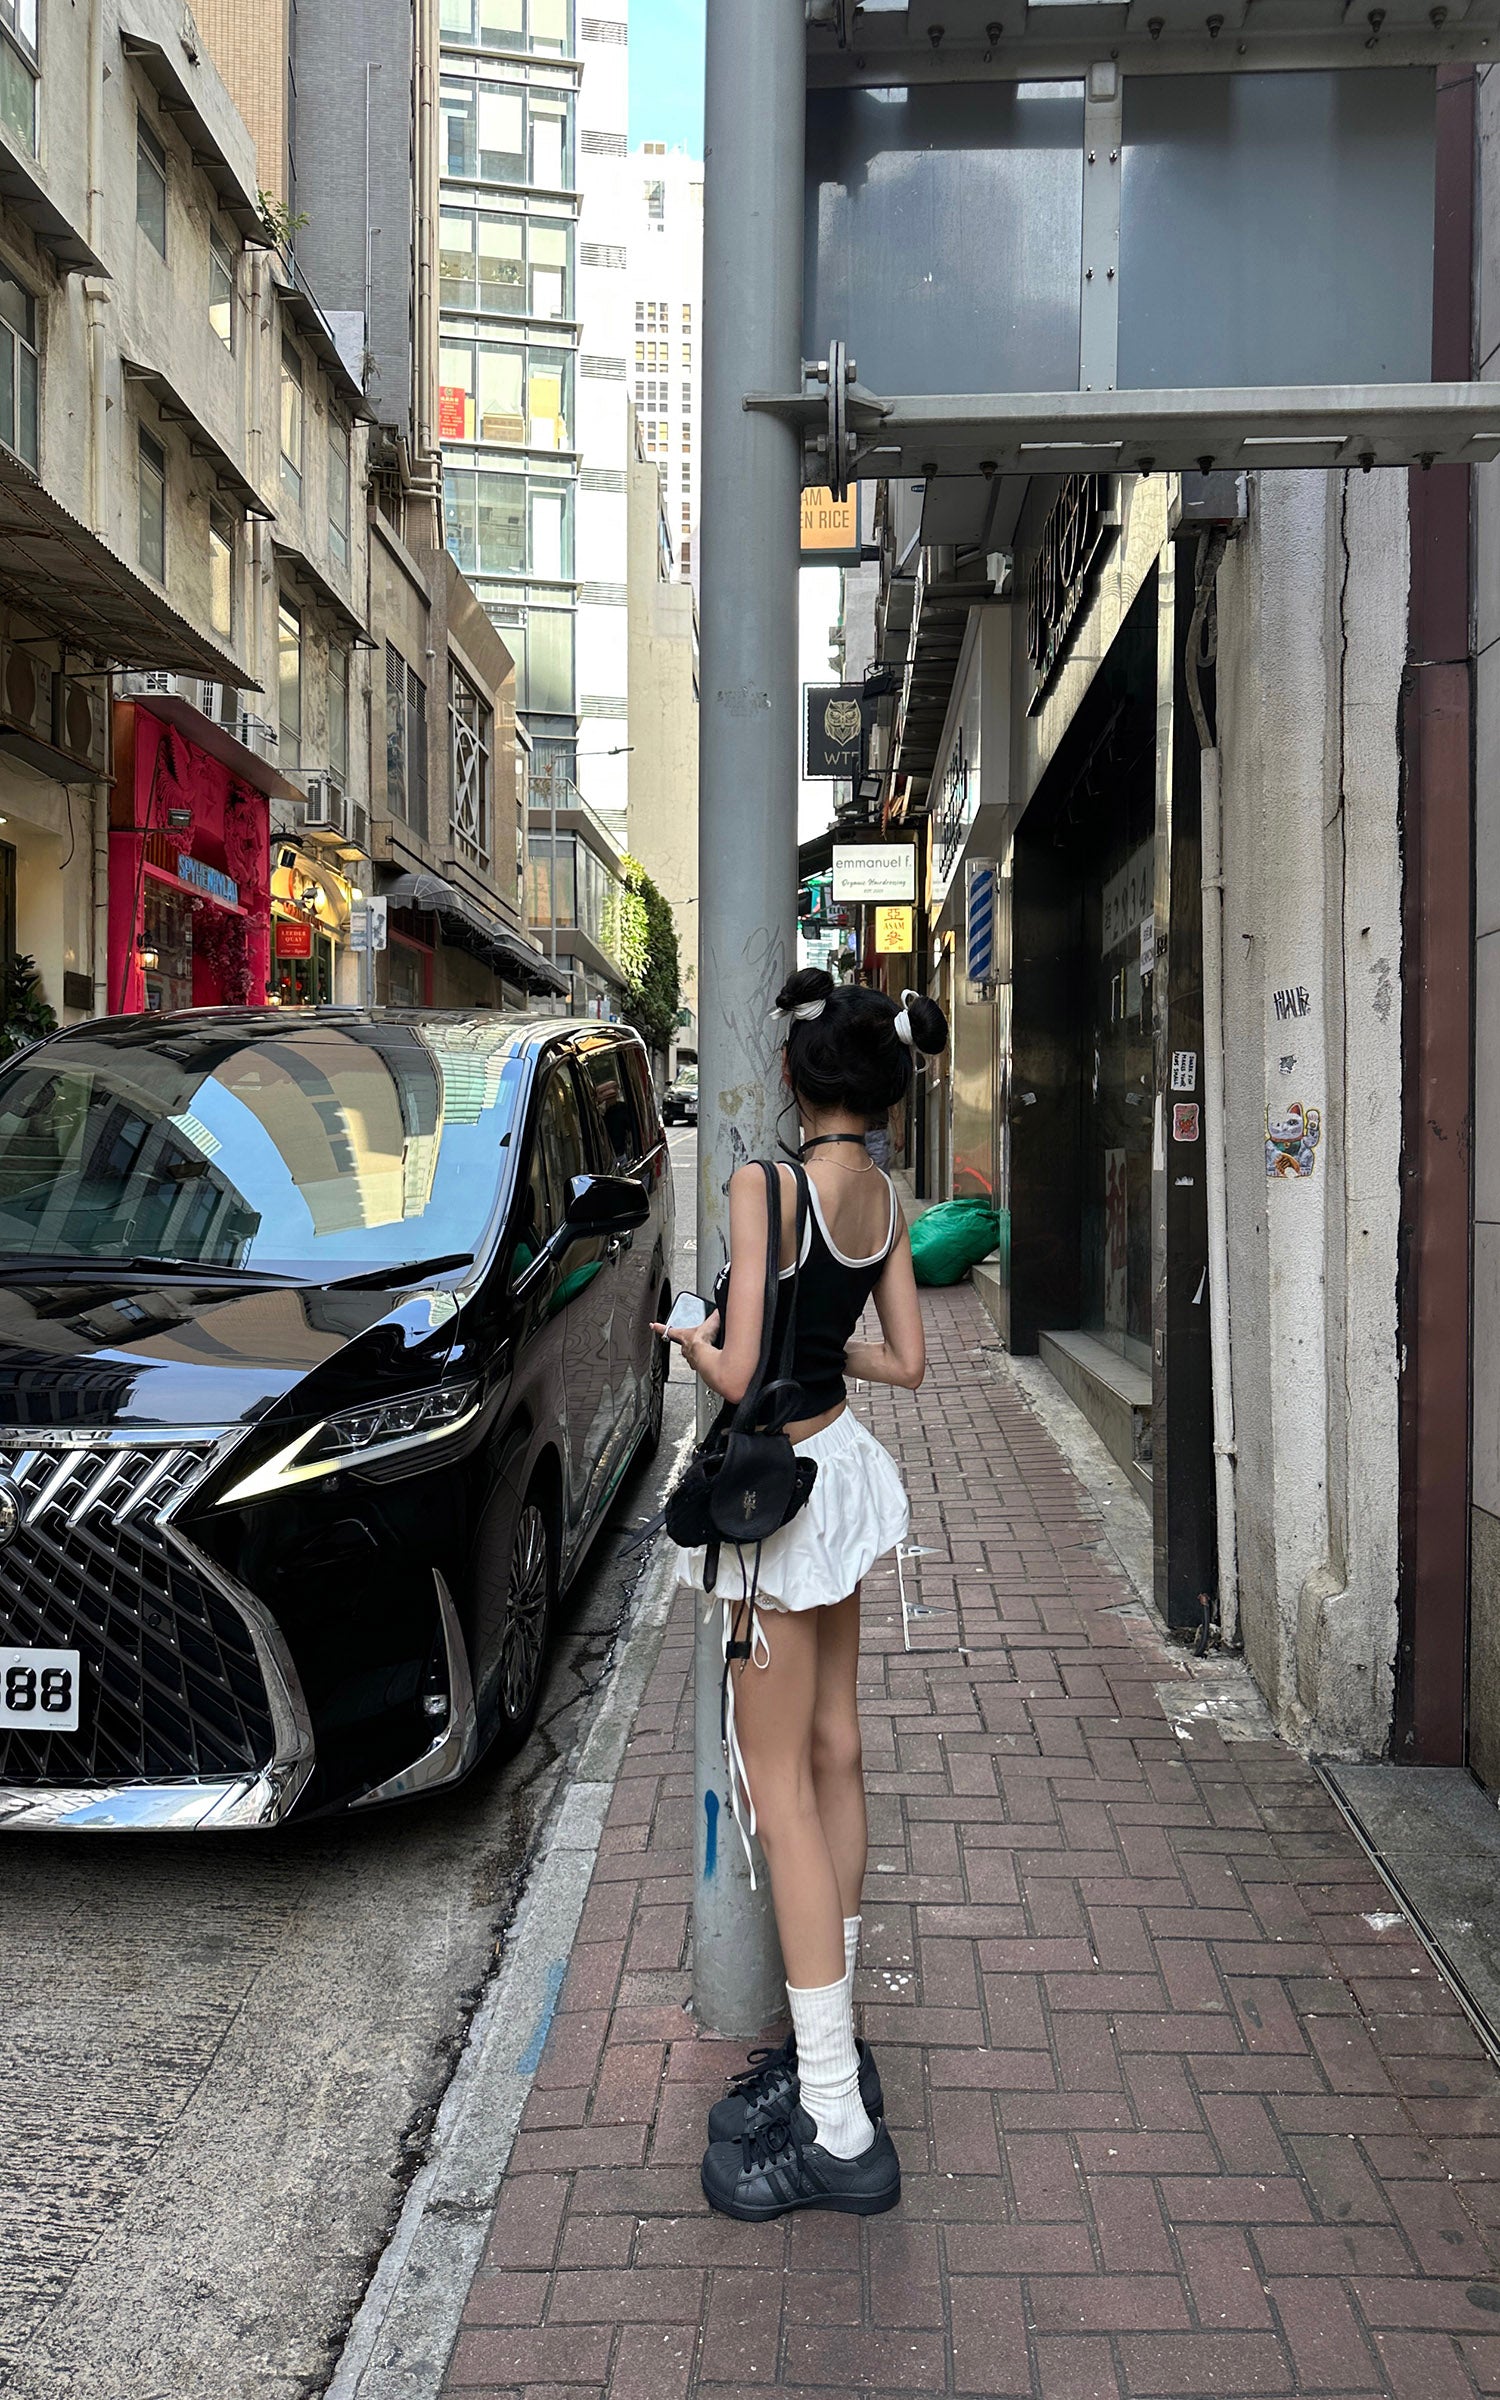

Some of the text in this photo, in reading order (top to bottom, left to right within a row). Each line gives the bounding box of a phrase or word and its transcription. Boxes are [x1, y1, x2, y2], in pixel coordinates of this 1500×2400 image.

[819, 510, 849, 528] RICE
[836, 856, 901, 868] emmanuel
[884, 908, 904, 921] 亞
[884, 922, 905, 930] ASAM
[0, 1666, 72, 1712] 88
